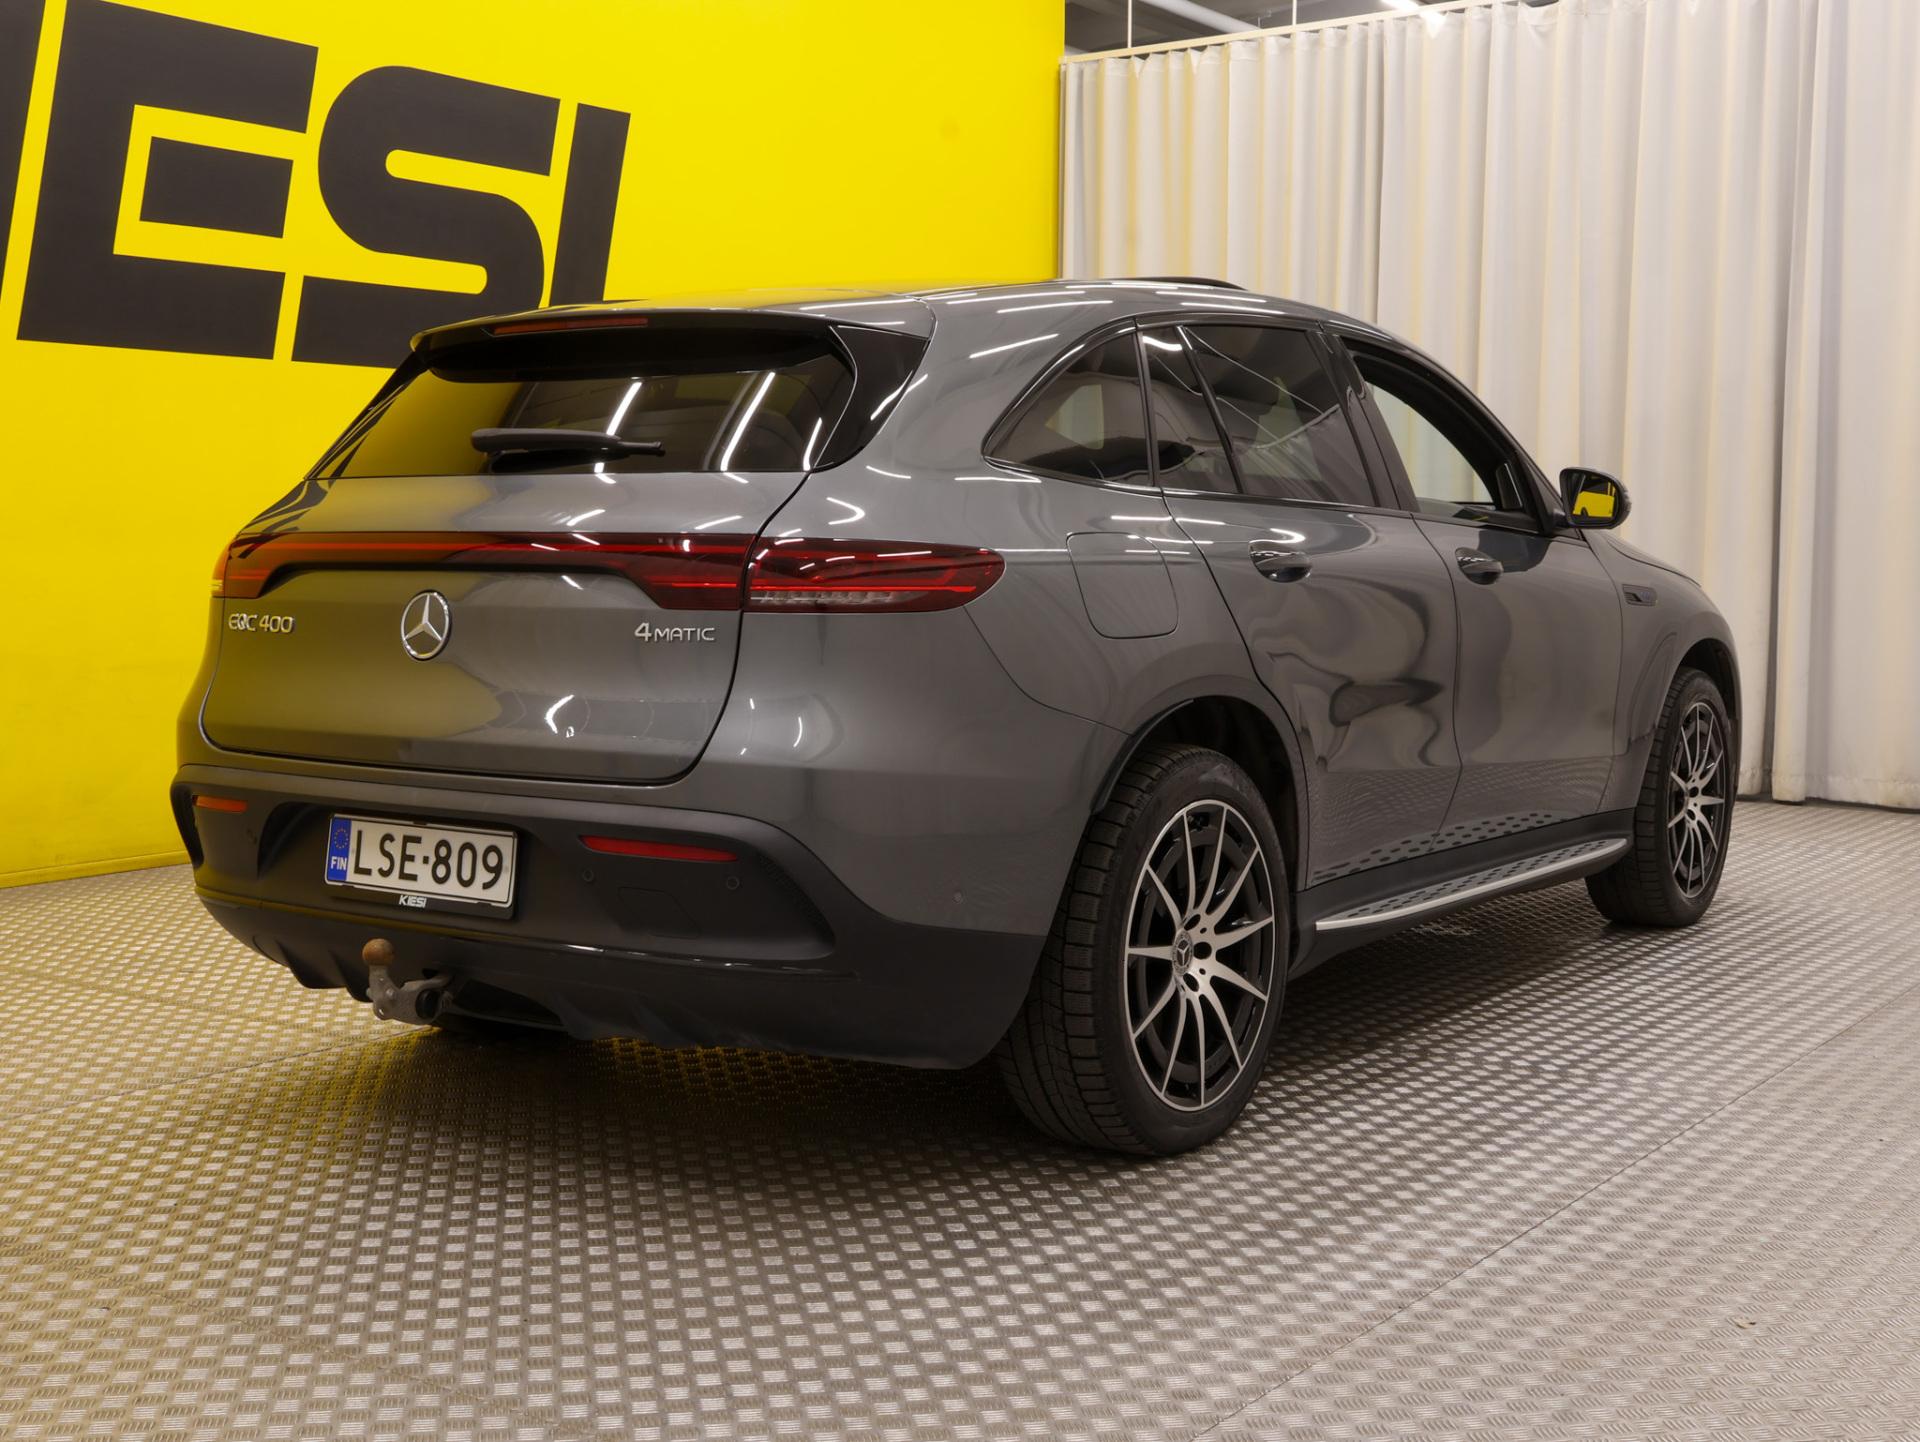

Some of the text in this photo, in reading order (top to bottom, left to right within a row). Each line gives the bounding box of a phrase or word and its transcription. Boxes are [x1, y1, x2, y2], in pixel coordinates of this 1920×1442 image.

[228, 612, 294, 634] EQC 400
[634, 622, 715, 642] 4MATIC
[330, 855, 348, 871] FIN
[353, 829, 504, 891] LSE-809
[398, 894, 428, 909] KIESI
